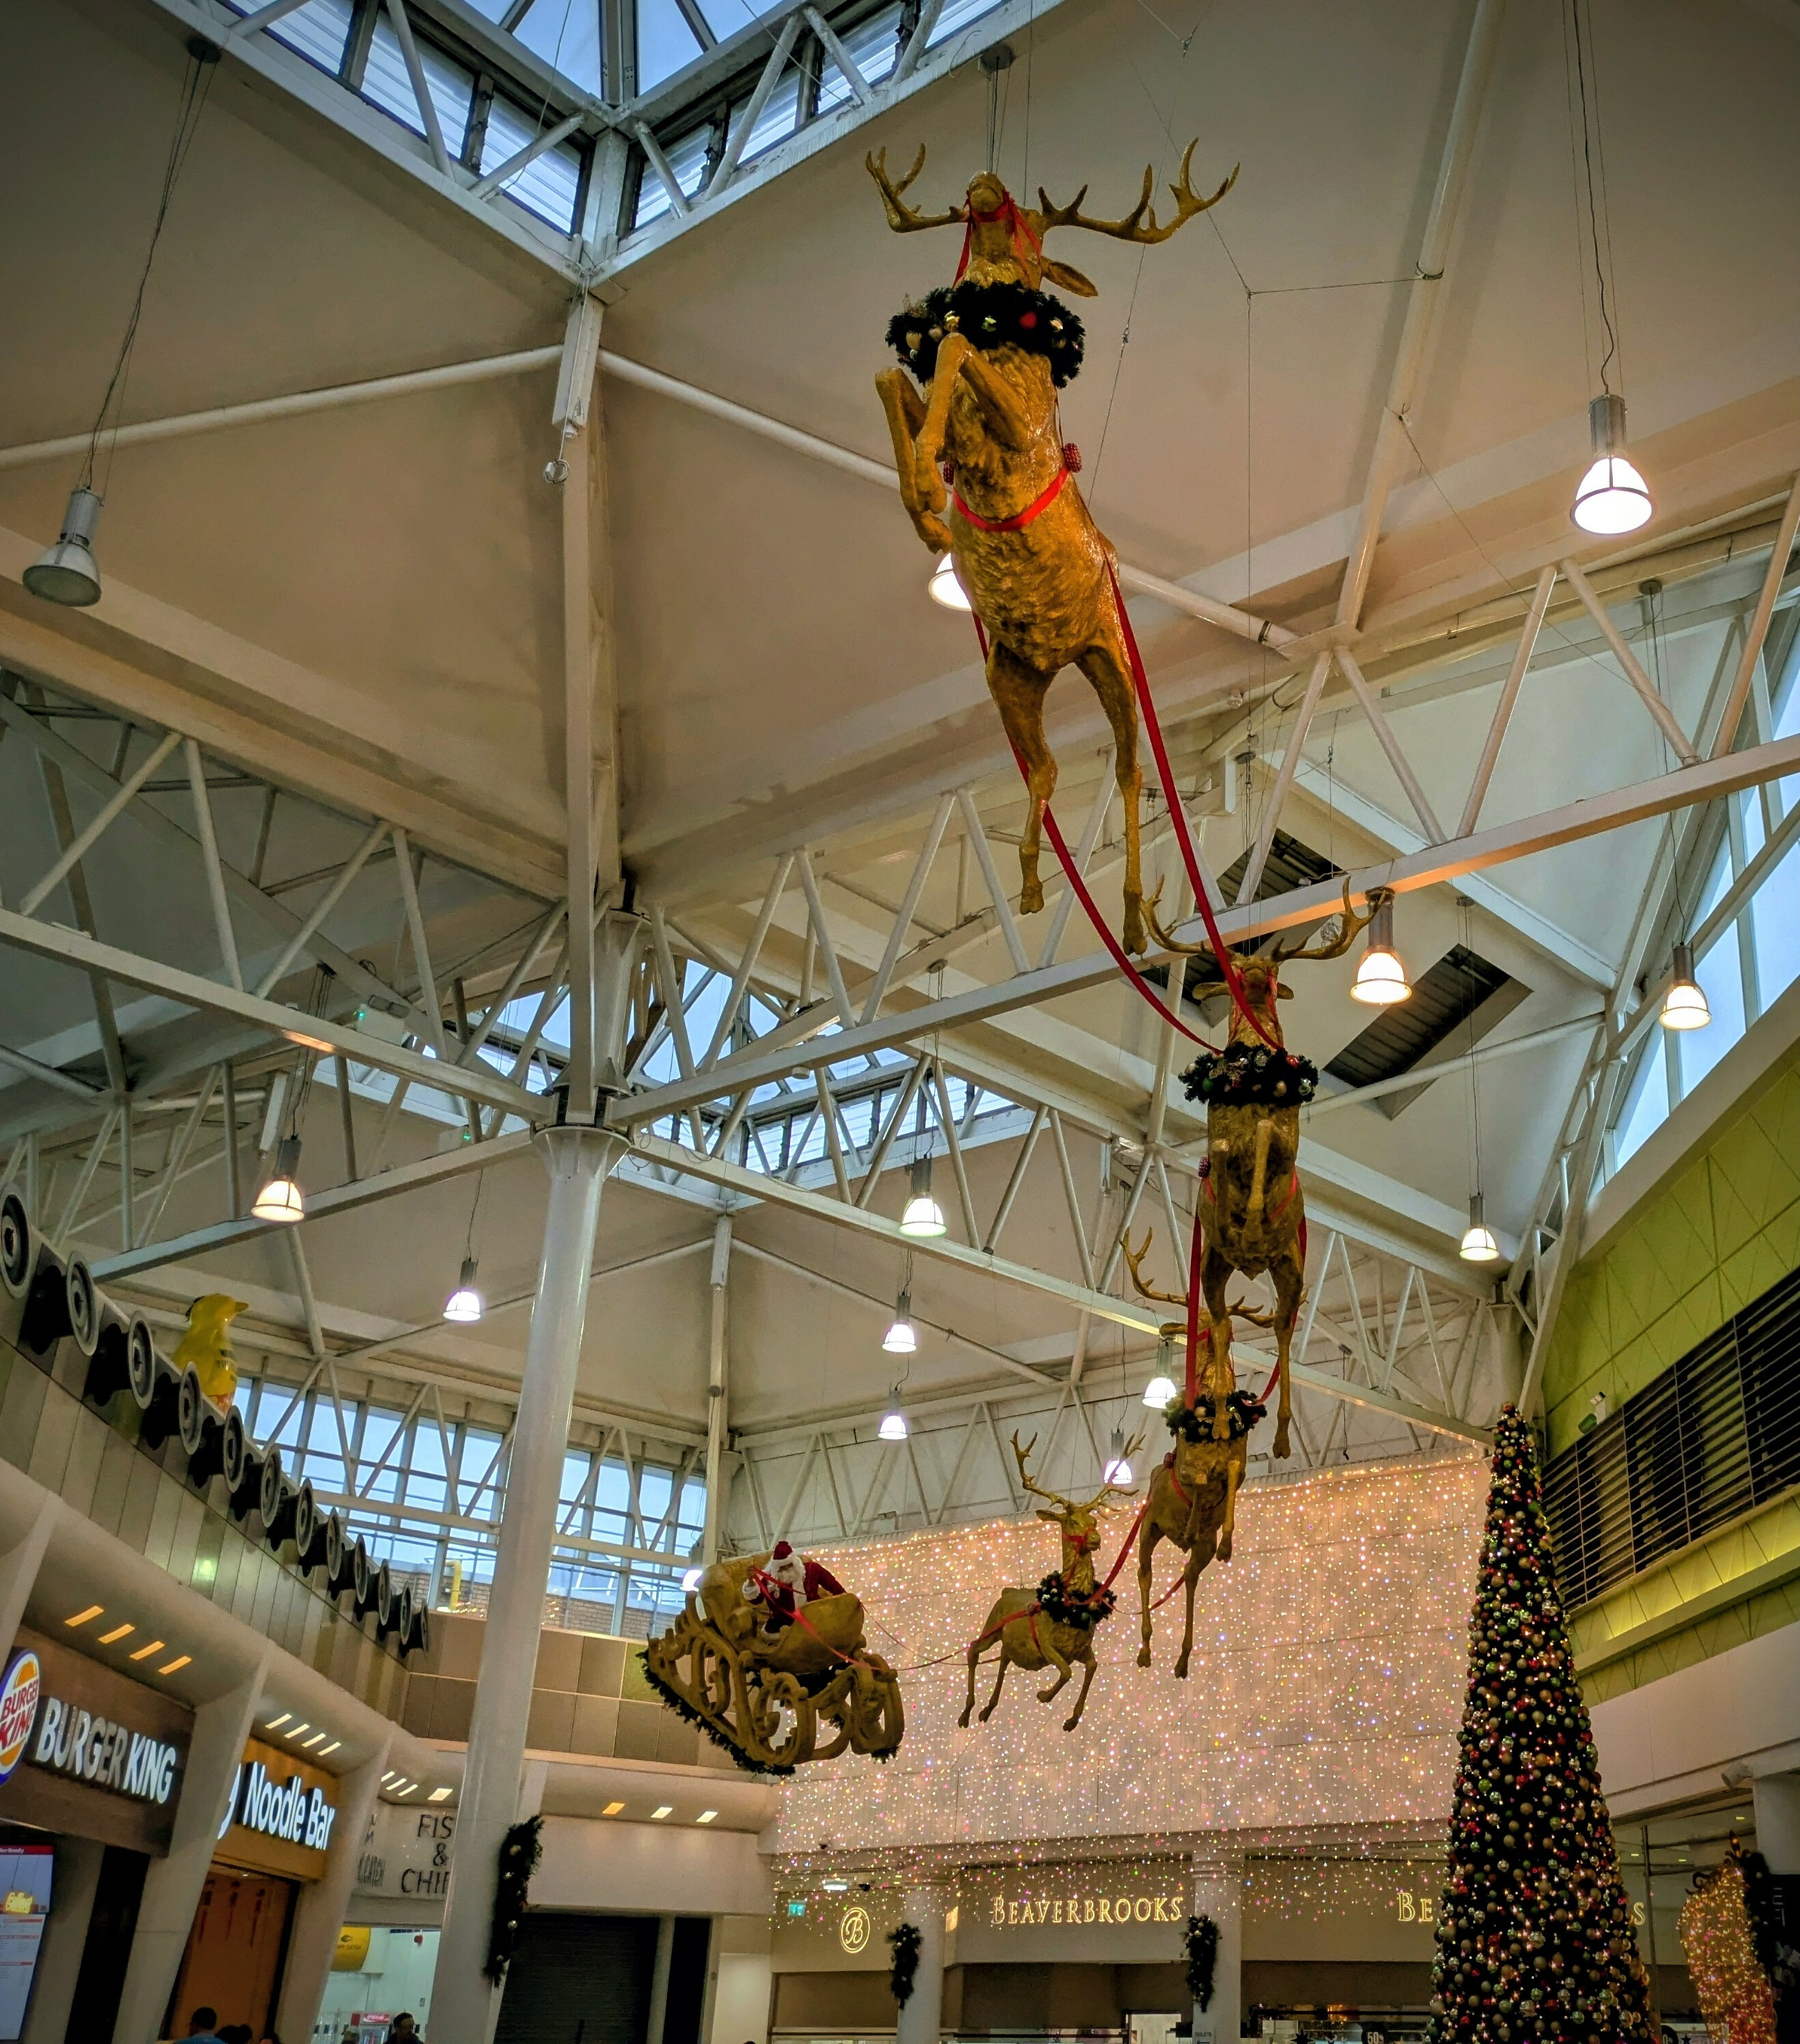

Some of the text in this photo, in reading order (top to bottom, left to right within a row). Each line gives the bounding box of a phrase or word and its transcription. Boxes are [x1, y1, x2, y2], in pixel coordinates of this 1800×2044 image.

[36, 1697, 128, 1788] BURGER
[123, 1733, 176, 1803] KING
[243, 1761, 306, 1842] Noodle
[305, 1787, 335, 1851] Bar
[417, 1814, 454, 1839] FIS
[432, 1843, 447, 1867] &
[993, 1896, 1183, 1924] BEAVERBROOKS
[845, 1911, 863, 1945] B
